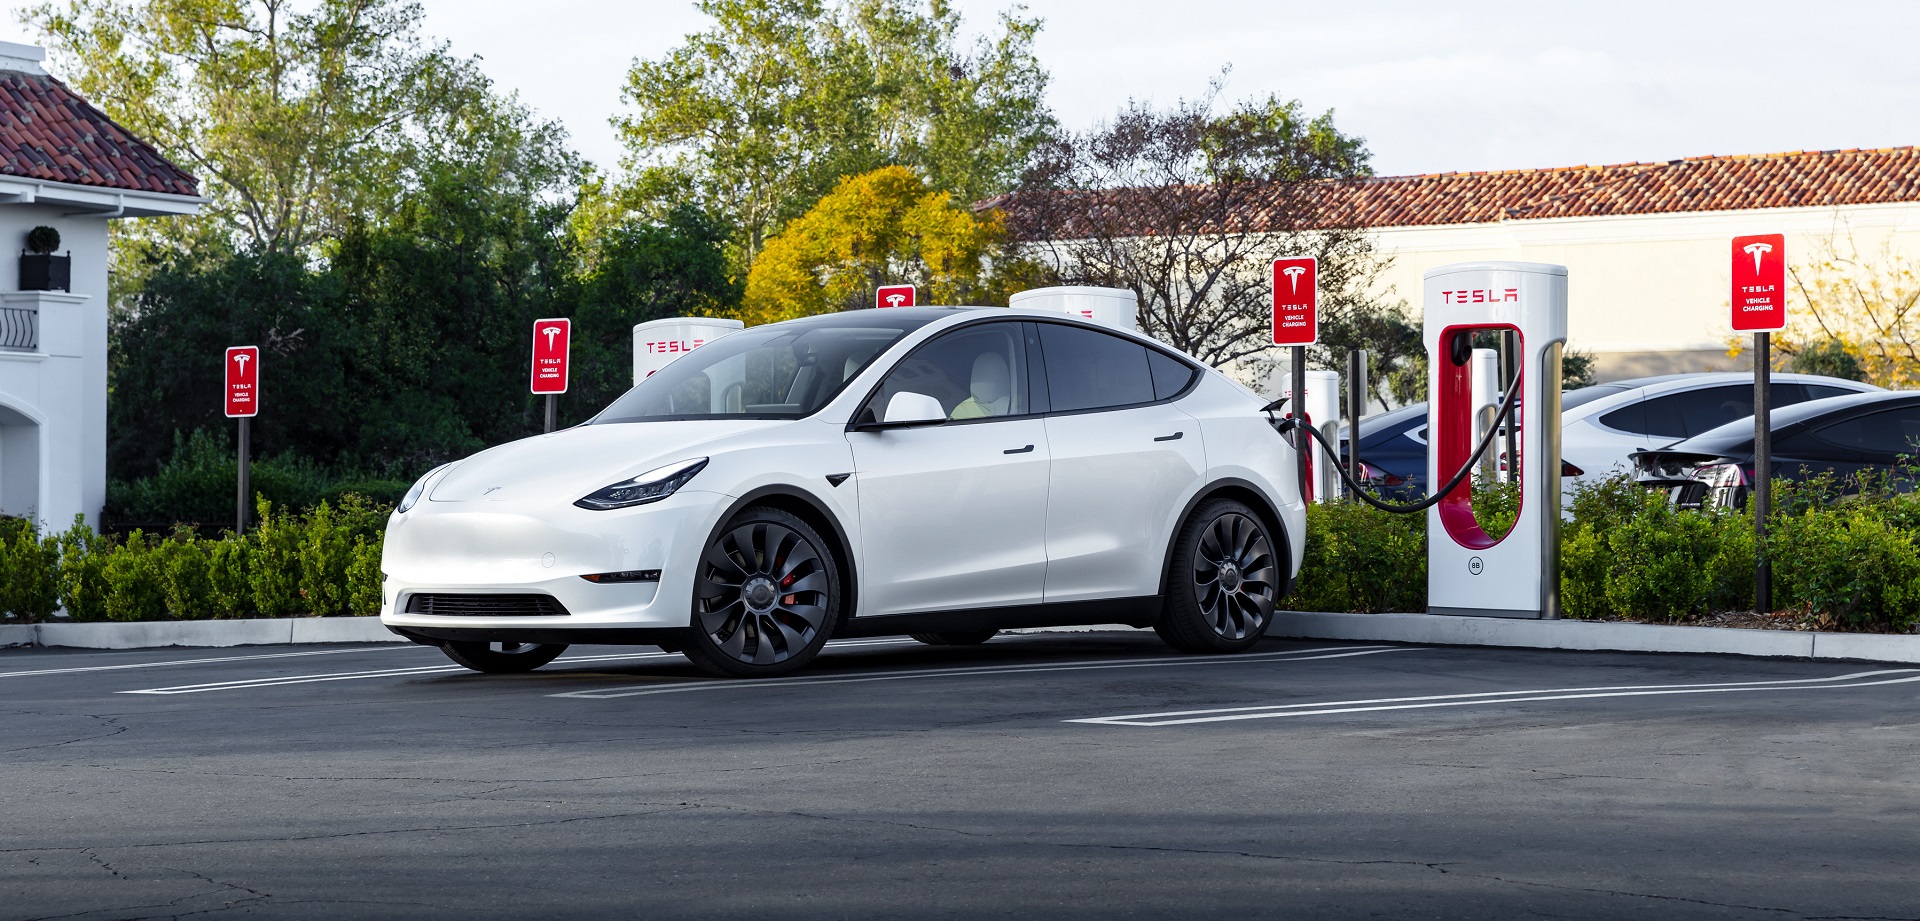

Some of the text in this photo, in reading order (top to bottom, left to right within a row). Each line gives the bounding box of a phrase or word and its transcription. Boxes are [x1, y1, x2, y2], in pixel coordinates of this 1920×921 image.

[1742, 284, 1775, 293] TESLA
[1441, 288, 1518, 304] TESLA
[1282, 303, 1308, 311] TESLA
[1742, 304, 1774, 312] CHARGING
